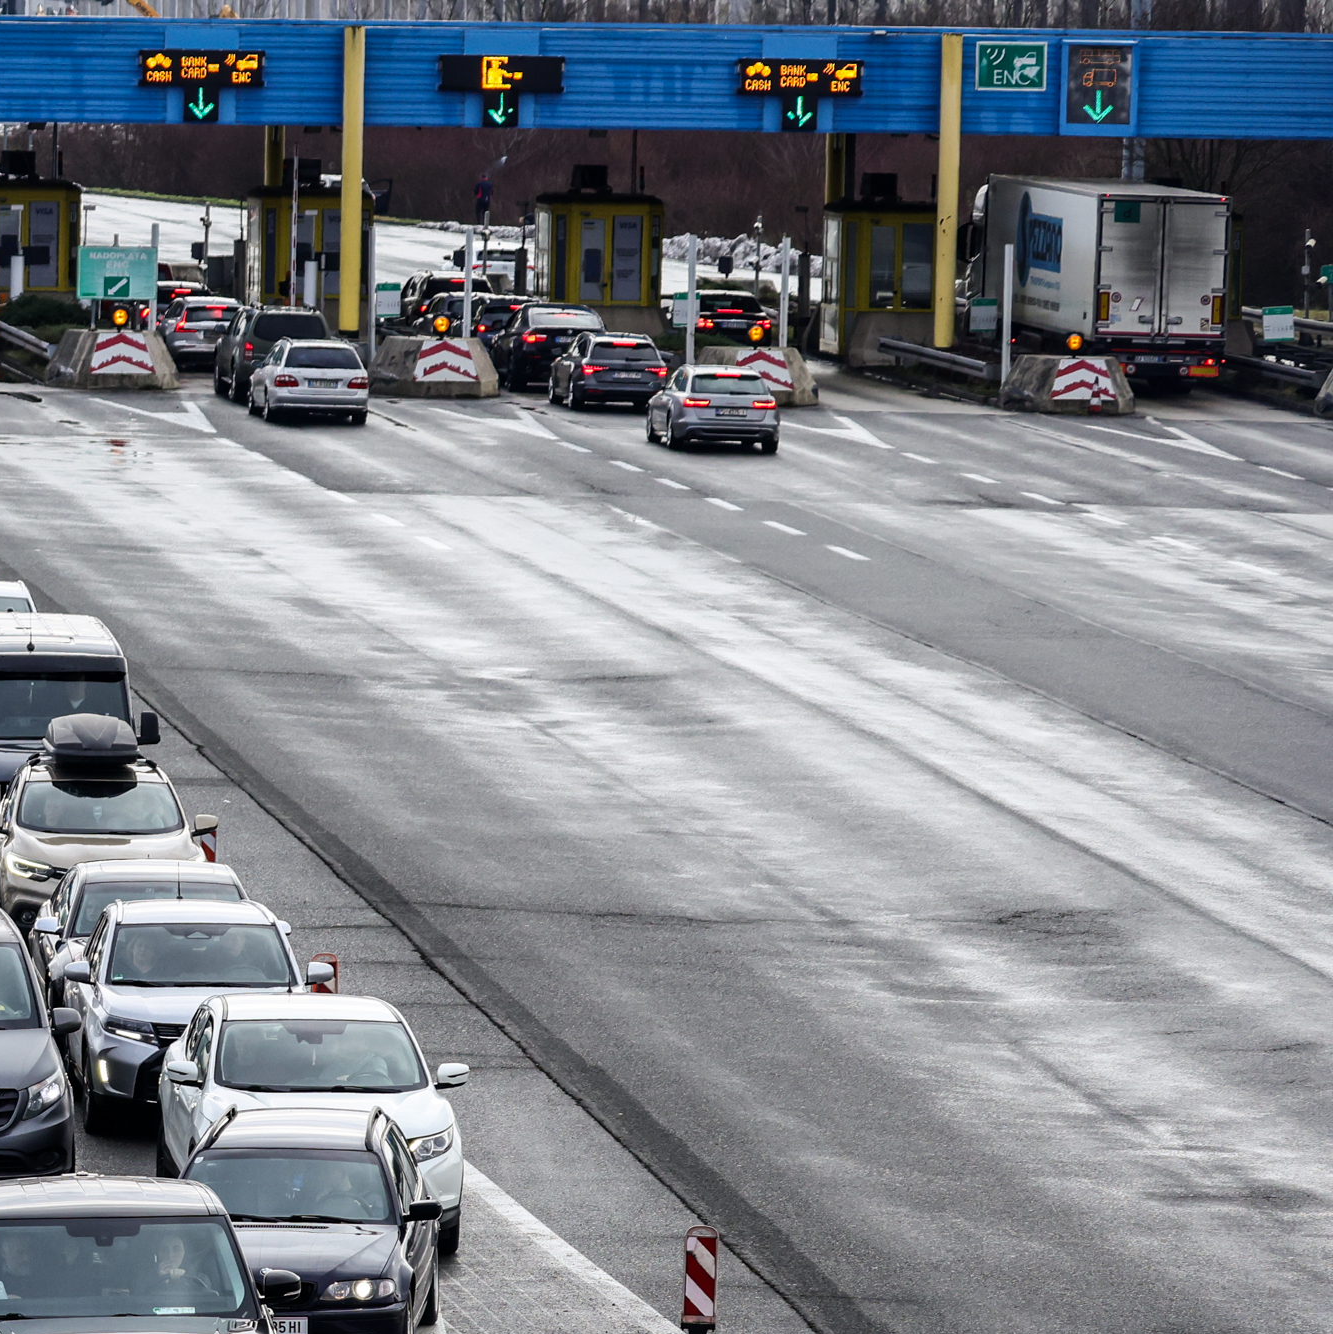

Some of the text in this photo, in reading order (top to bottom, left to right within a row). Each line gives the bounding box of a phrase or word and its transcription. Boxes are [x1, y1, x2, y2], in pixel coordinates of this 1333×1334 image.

[181, 56, 207, 66] BANK
[146, 67, 252, 83] CASH CARD ENC
[781, 65, 807, 76] BANK
[993, 70, 1030, 85] ENC
[745, 76, 851, 92] CASH CARD ENC
[90, 252, 148, 260] NADOPLATA
[106, 261, 130, 269] ENC
[289, 1321, 301, 1333] HI
